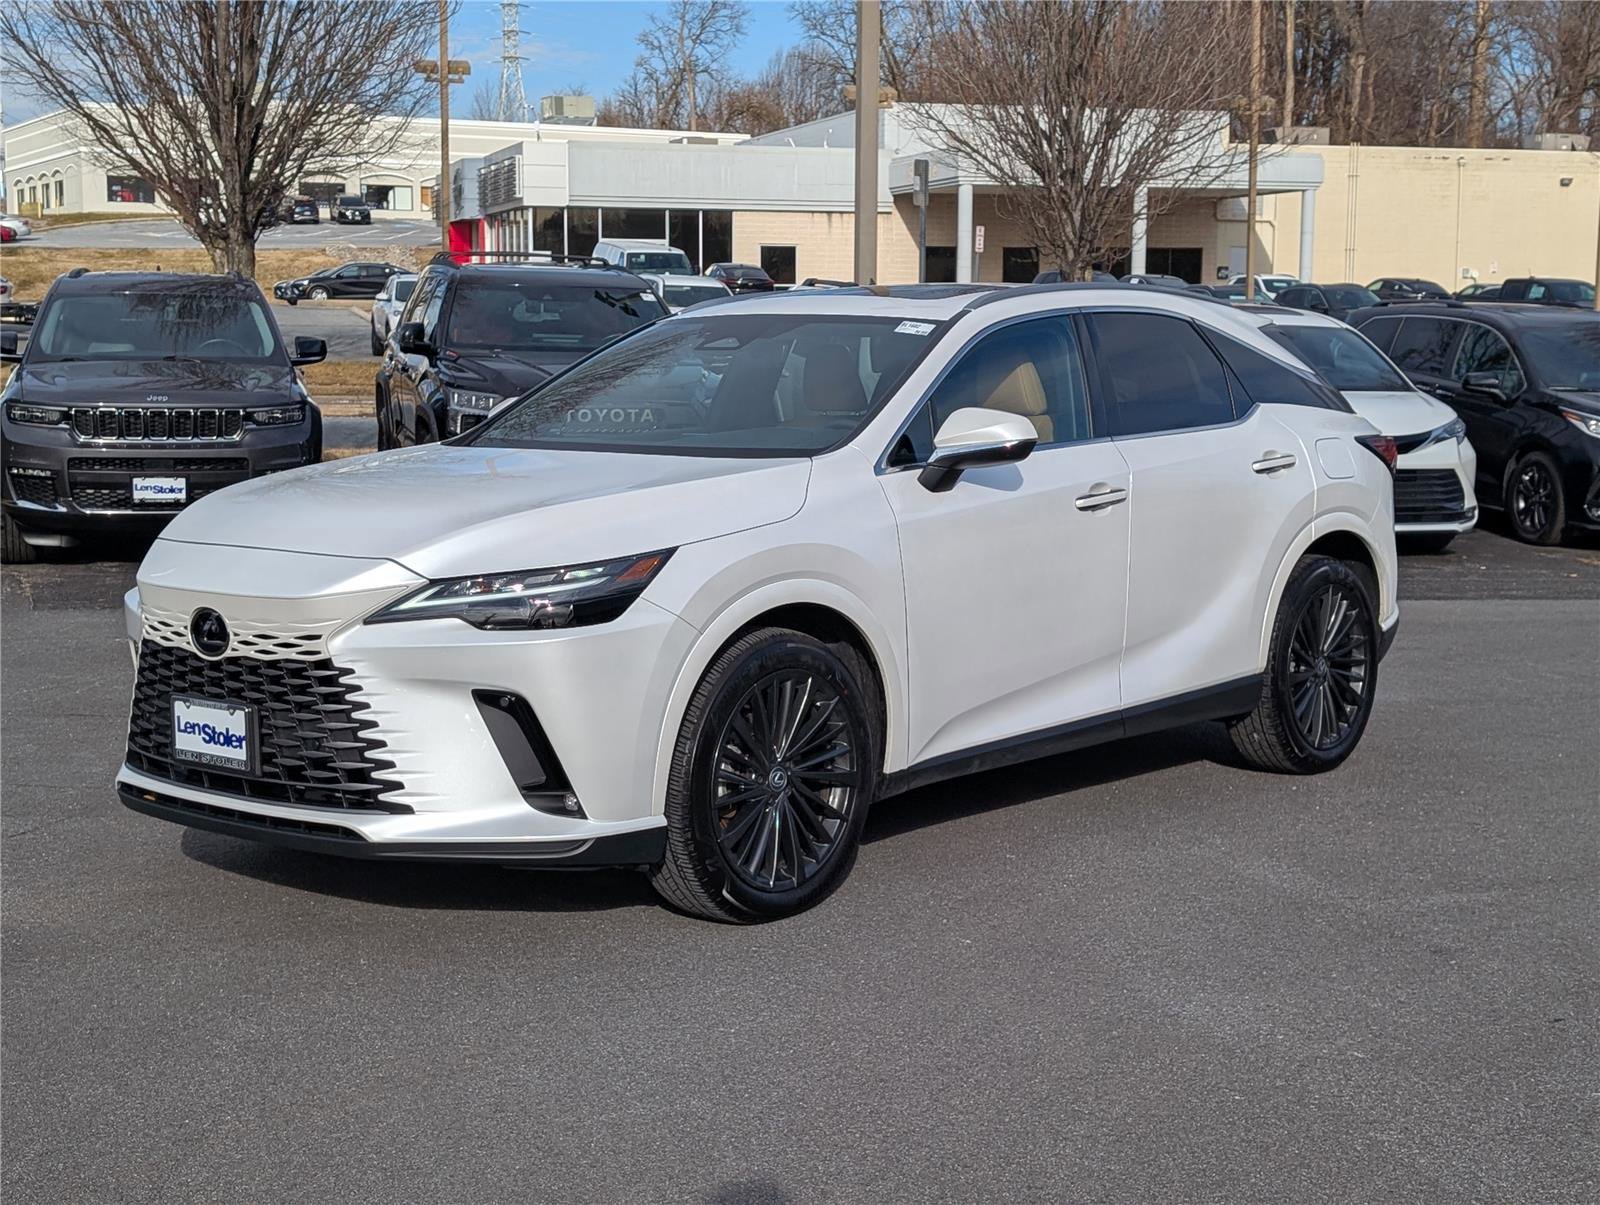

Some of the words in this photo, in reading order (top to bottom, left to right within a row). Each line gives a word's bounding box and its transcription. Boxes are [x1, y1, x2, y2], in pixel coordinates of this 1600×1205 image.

[146, 394, 169, 402] Jeep
[566, 408, 654, 423] TOYOTA
[176, 749, 199, 761] LEN
[201, 754, 246, 770] STOLER
